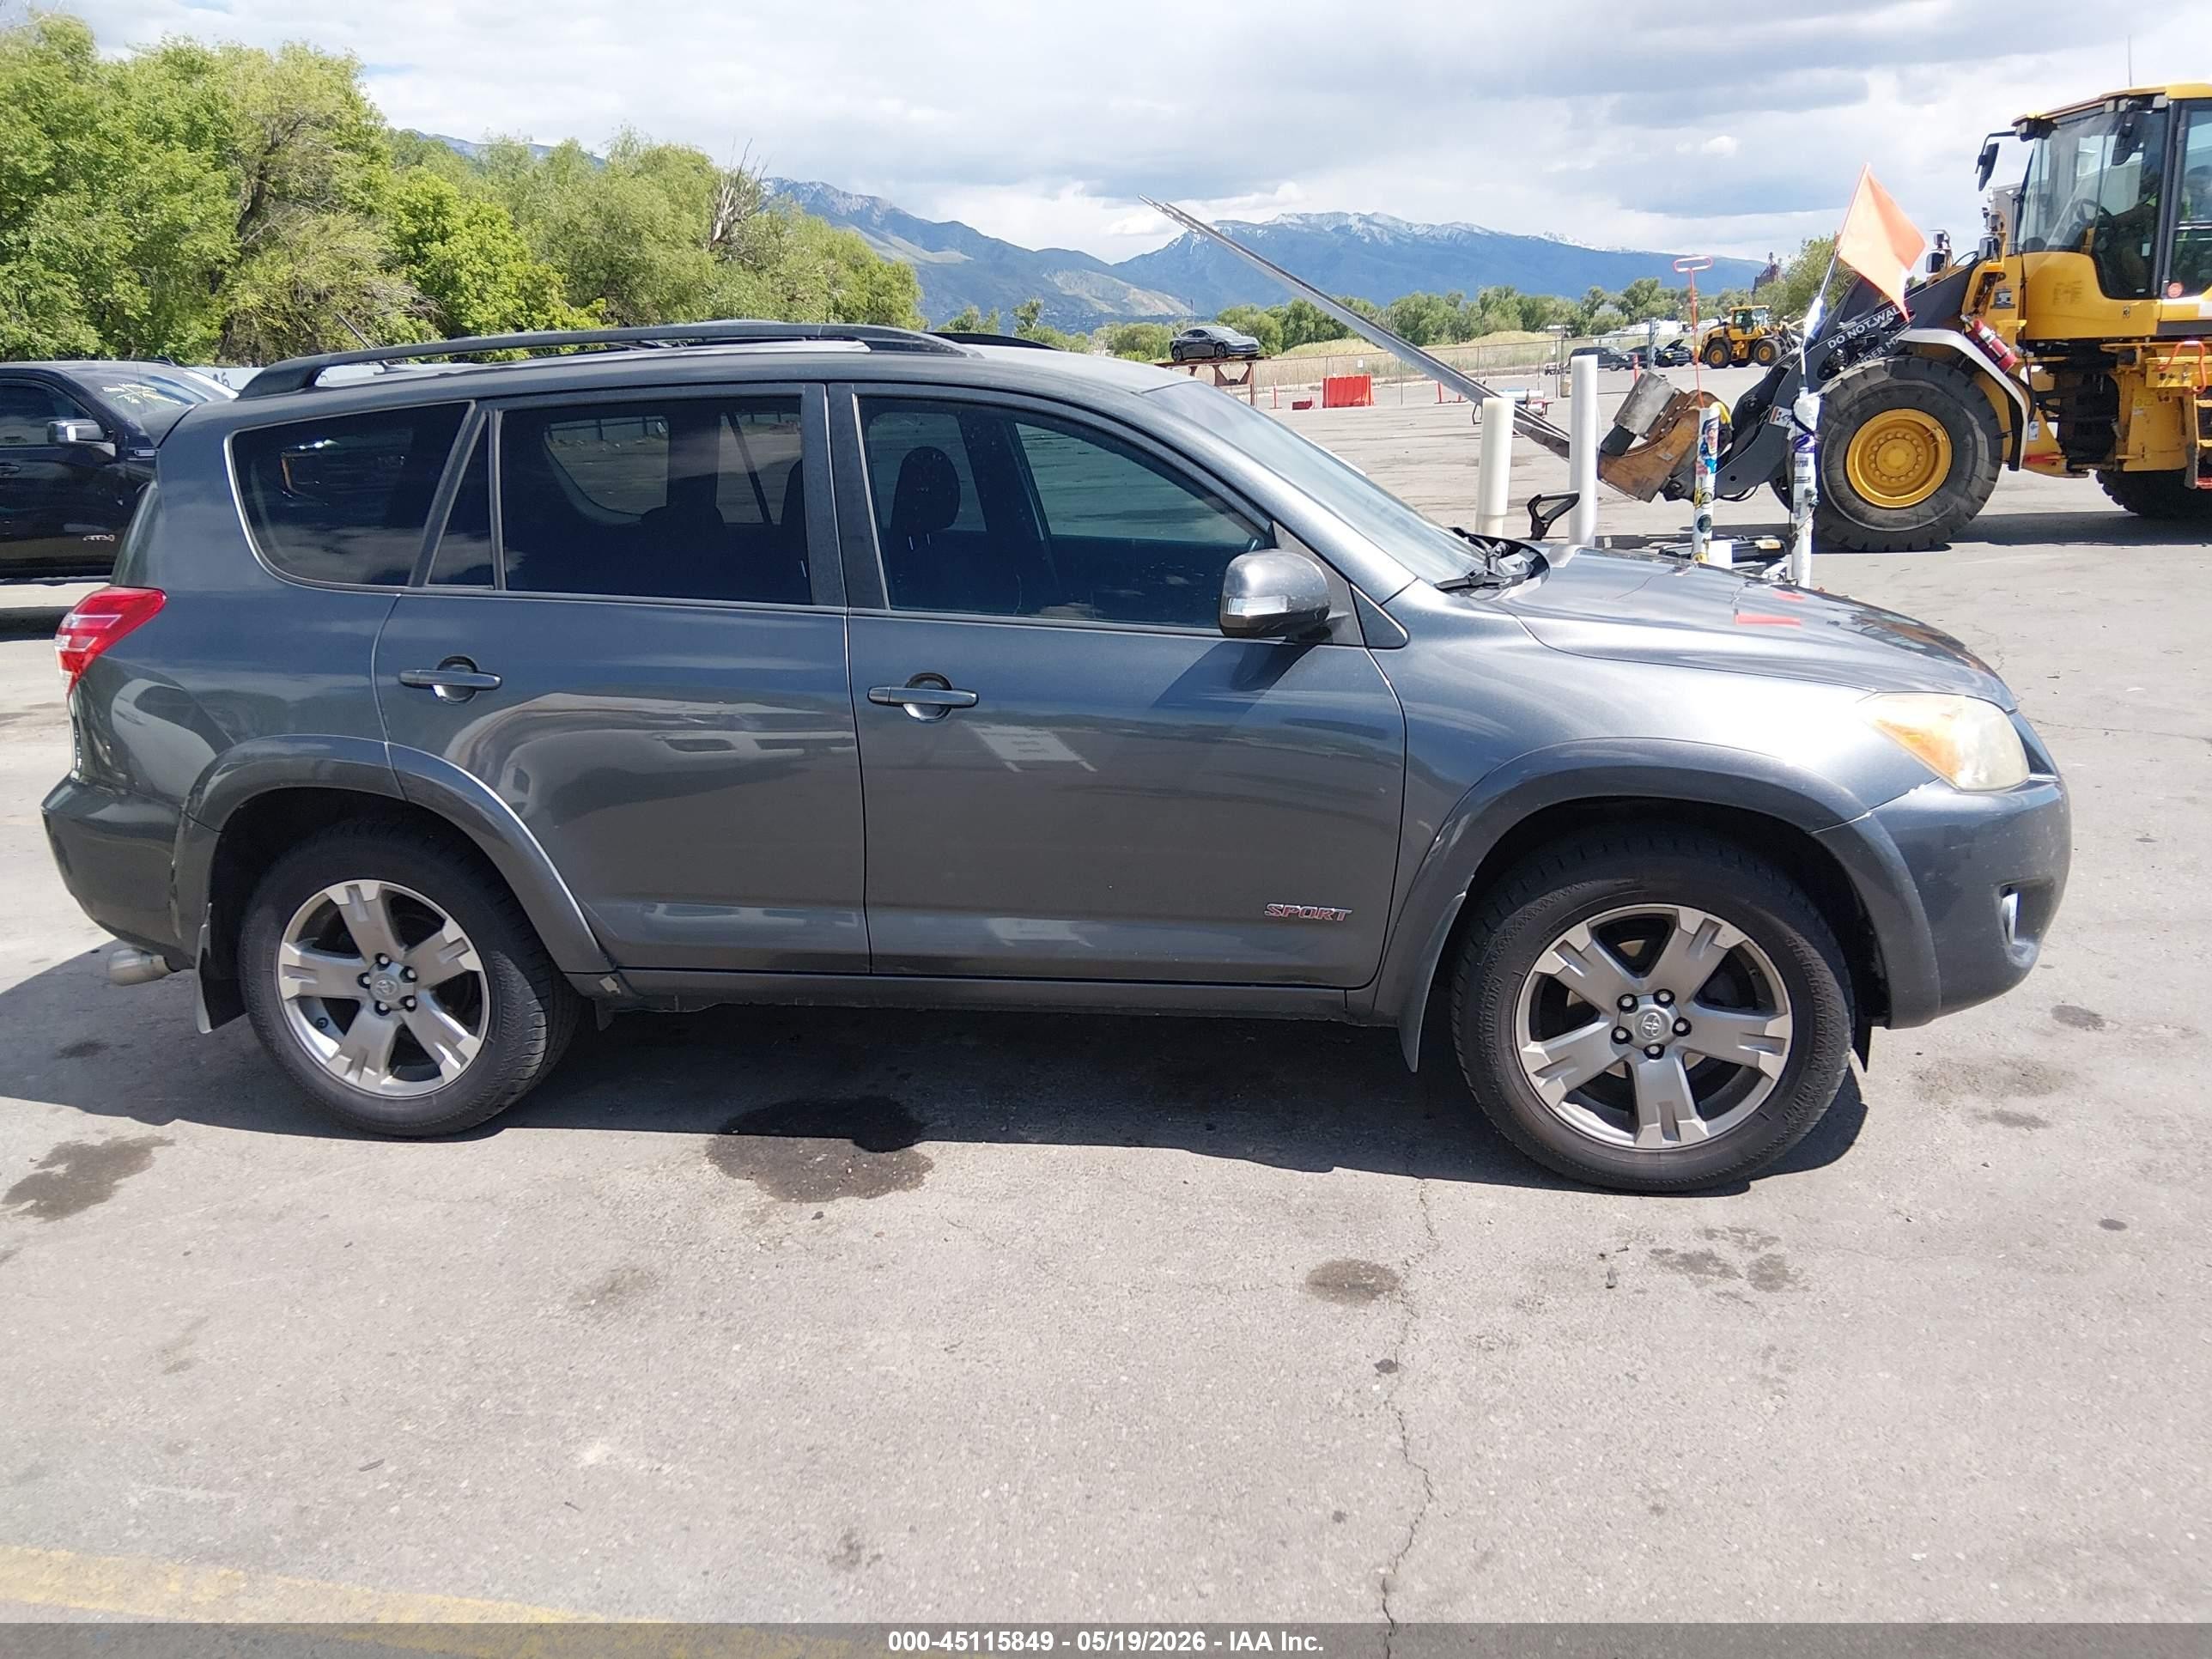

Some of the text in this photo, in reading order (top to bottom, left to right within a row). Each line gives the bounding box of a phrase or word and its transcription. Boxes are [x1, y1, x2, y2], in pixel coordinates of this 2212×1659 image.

[1827, 307, 1901, 349] DO NOT WAL
[1264, 903, 1352, 921] SPORT
